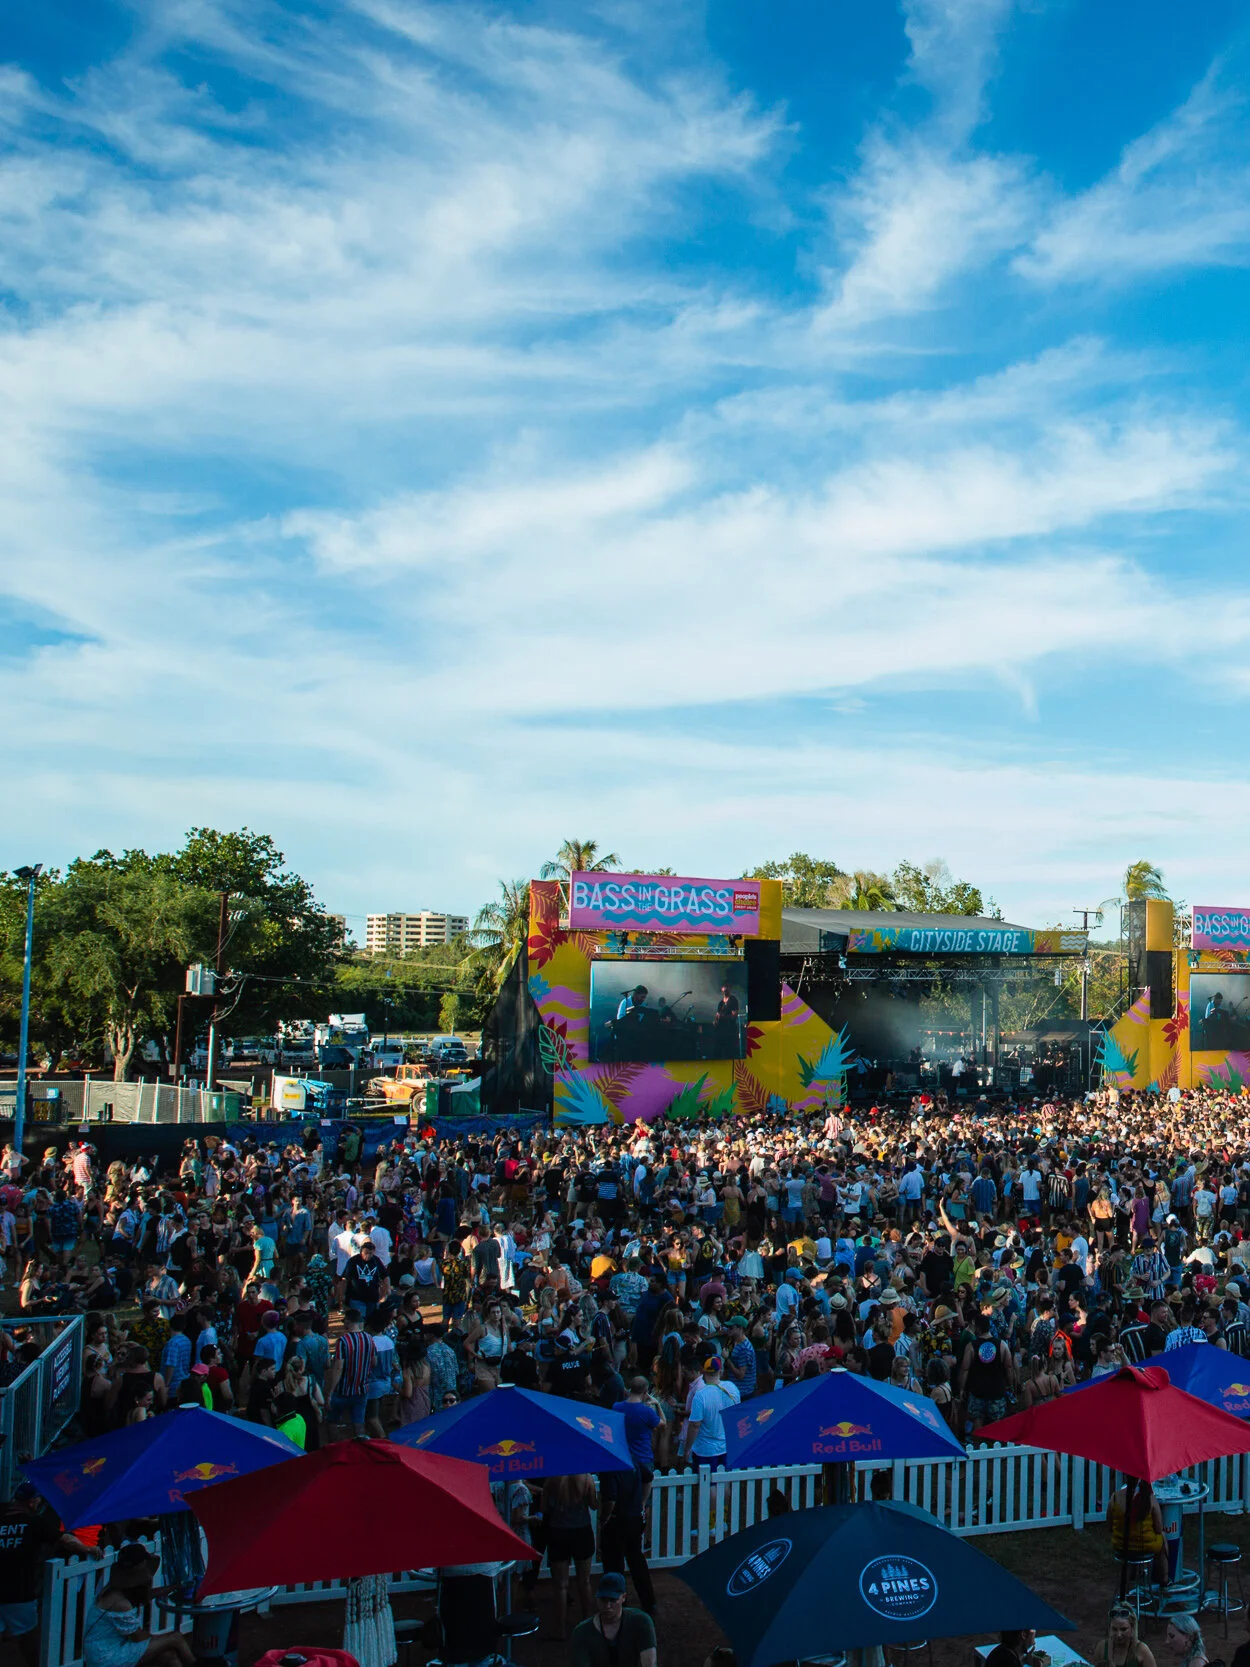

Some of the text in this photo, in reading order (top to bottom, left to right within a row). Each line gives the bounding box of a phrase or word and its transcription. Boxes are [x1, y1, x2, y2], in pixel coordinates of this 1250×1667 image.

[573, 882, 730, 915] BASS IN THE GRASS
[1194, 913, 1230, 935] BASS
[910, 930, 1021, 952] CITYSIDE STAGE
[1223, 1397, 1249, 1412] Red
[811, 1439, 882, 1454] Red Bull
[508, 1456, 544, 1472] Bull
[868, 1577, 930, 1595] 4 PINES
[885, 1594, 919, 1602] BREWING
